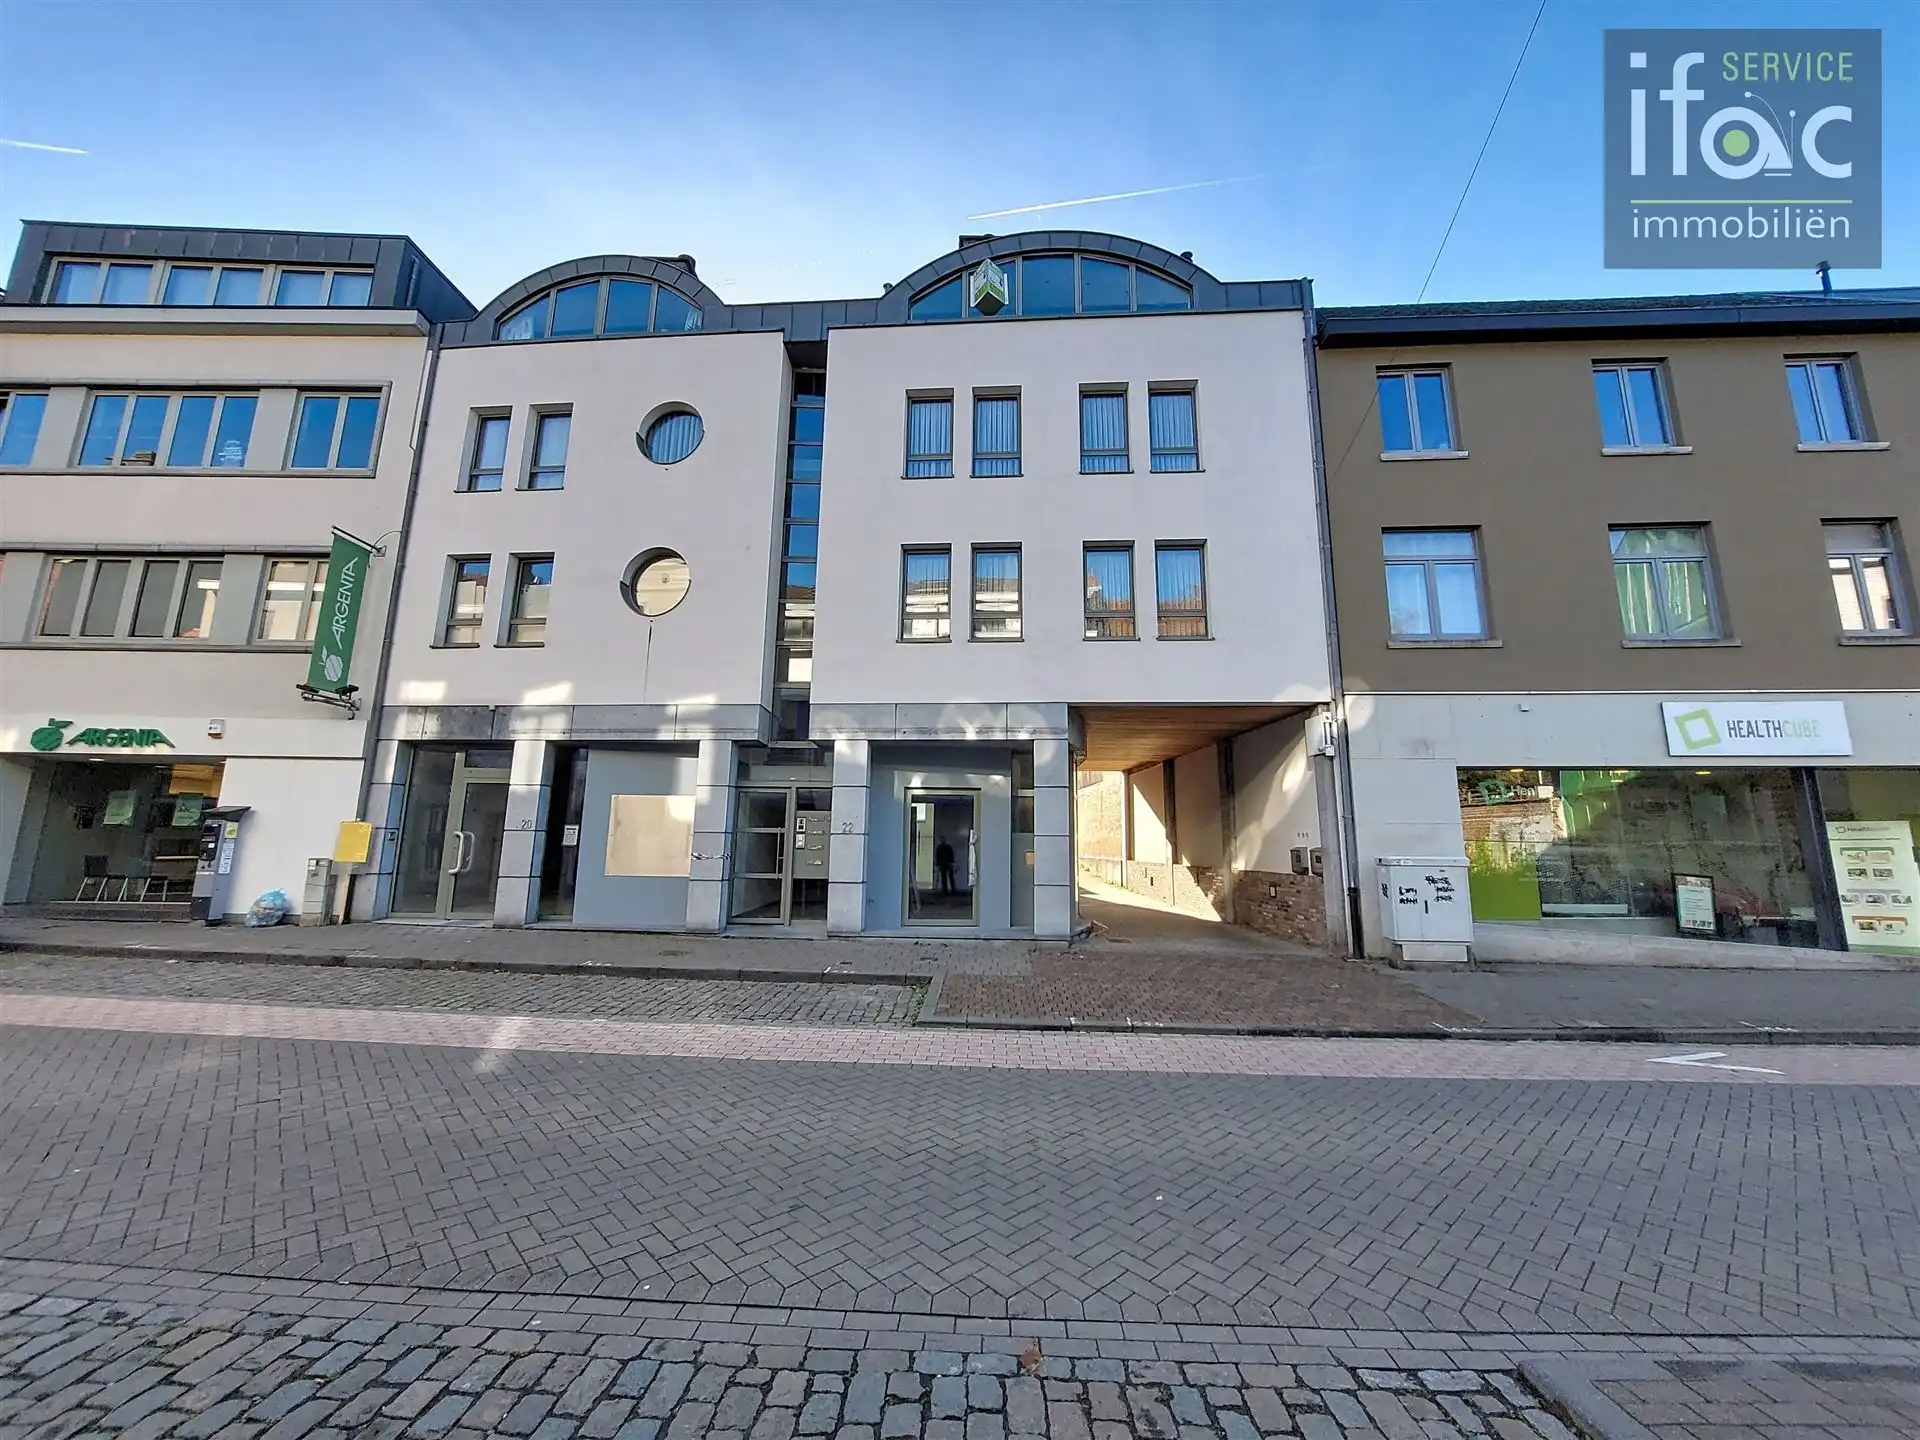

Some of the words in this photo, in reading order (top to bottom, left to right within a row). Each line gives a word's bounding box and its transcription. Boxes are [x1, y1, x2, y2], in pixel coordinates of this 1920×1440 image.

[332, 556, 358, 650] ARGENTA
[65, 727, 176, 748] ARGENTA
[1726, 719, 1821, 738] HEALTHCUBE
[521, 819, 533, 829] 20
[841, 822, 854, 833] 22
